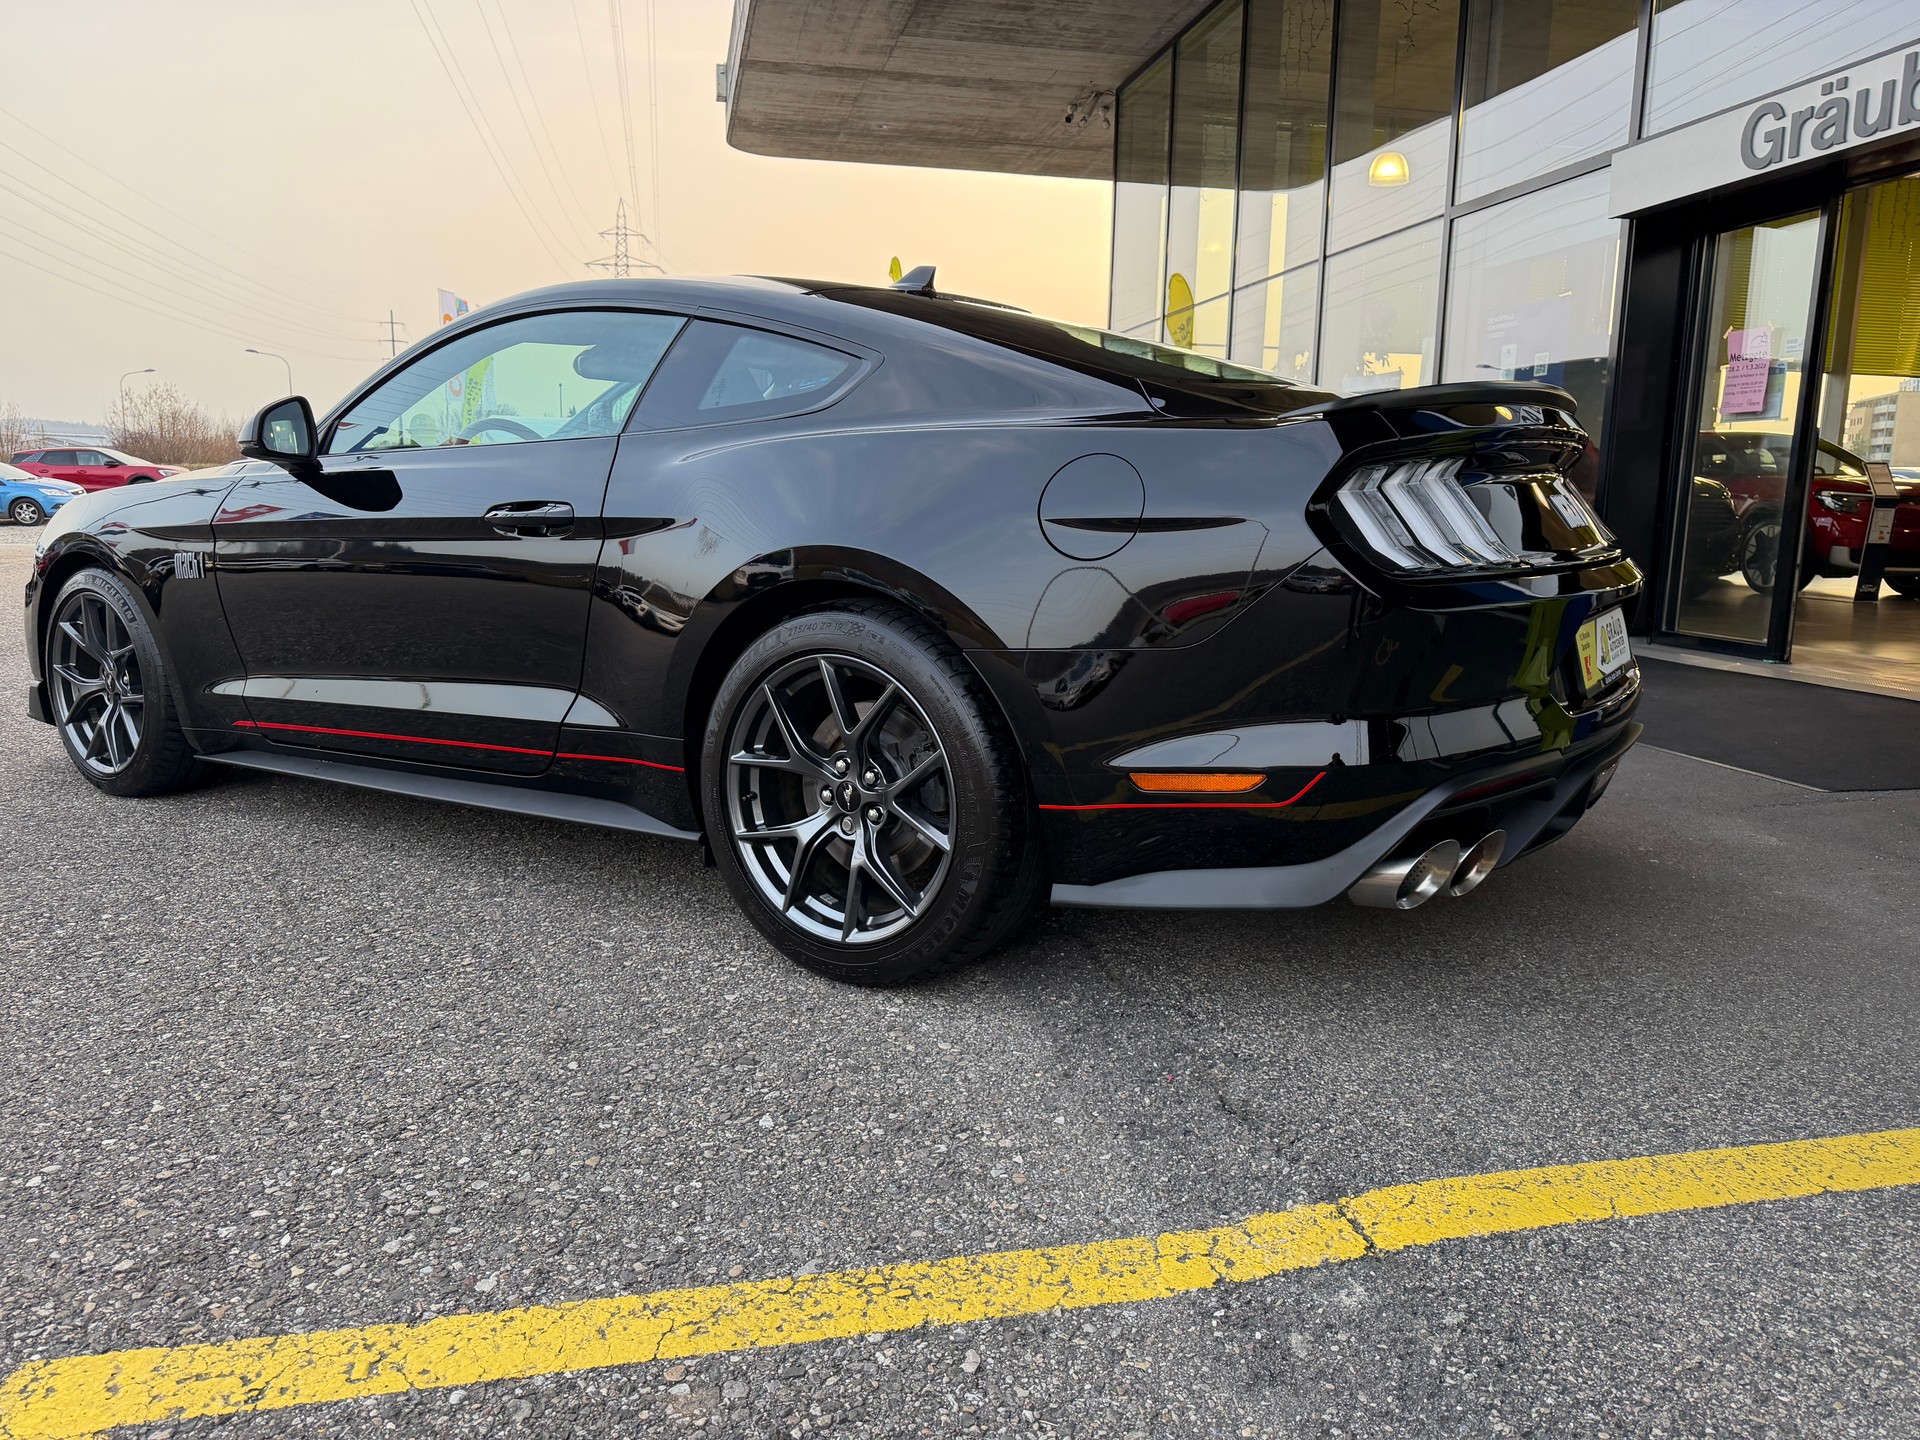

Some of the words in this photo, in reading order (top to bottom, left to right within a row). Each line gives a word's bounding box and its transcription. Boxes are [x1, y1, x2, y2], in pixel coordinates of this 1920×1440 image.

[1730, 351, 1768, 362] Metzgete
[94, 578, 135, 621] MICHELIN
[788, 622, 818, 636] 275/40
[819, 622, 832, 631] ZR
[834, 622, 843, 631] 19
